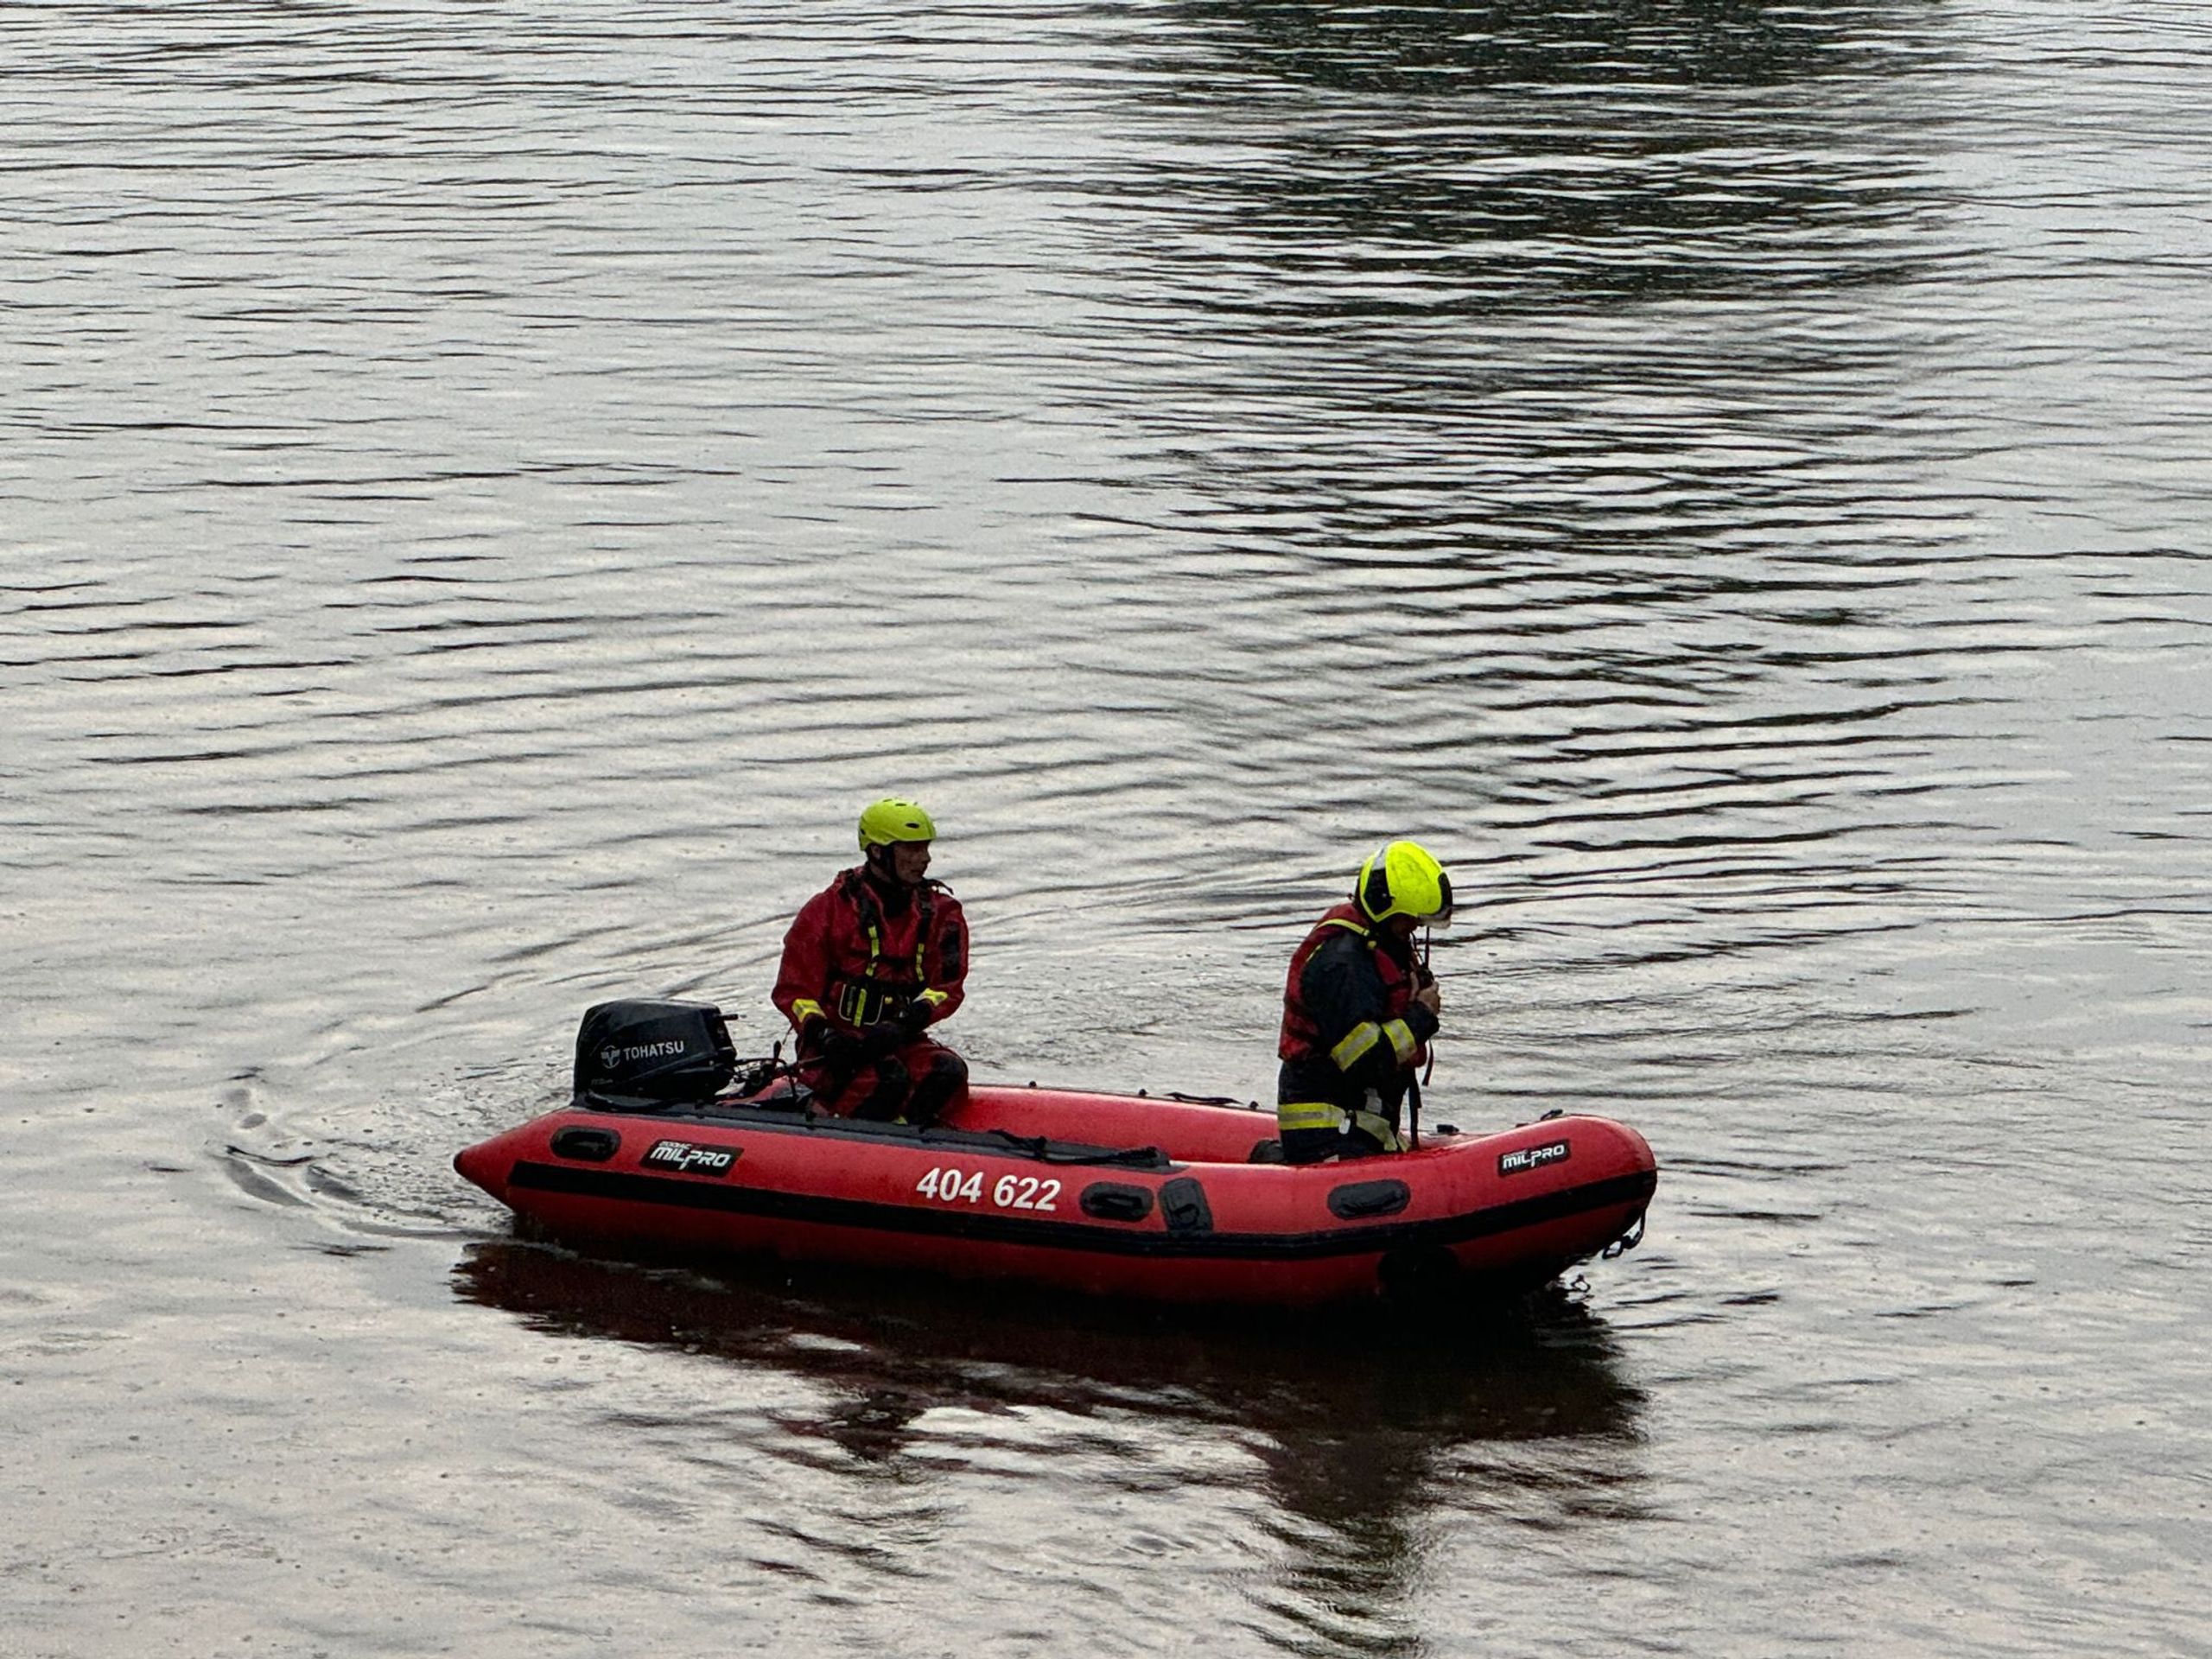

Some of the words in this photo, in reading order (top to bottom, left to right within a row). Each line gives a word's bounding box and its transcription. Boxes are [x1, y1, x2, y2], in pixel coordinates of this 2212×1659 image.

[623, 1040, 685, 1061] TOHATSU
[916, 1167, 984, 1204] 404
[994, 1175, 1061, 1211] 622
